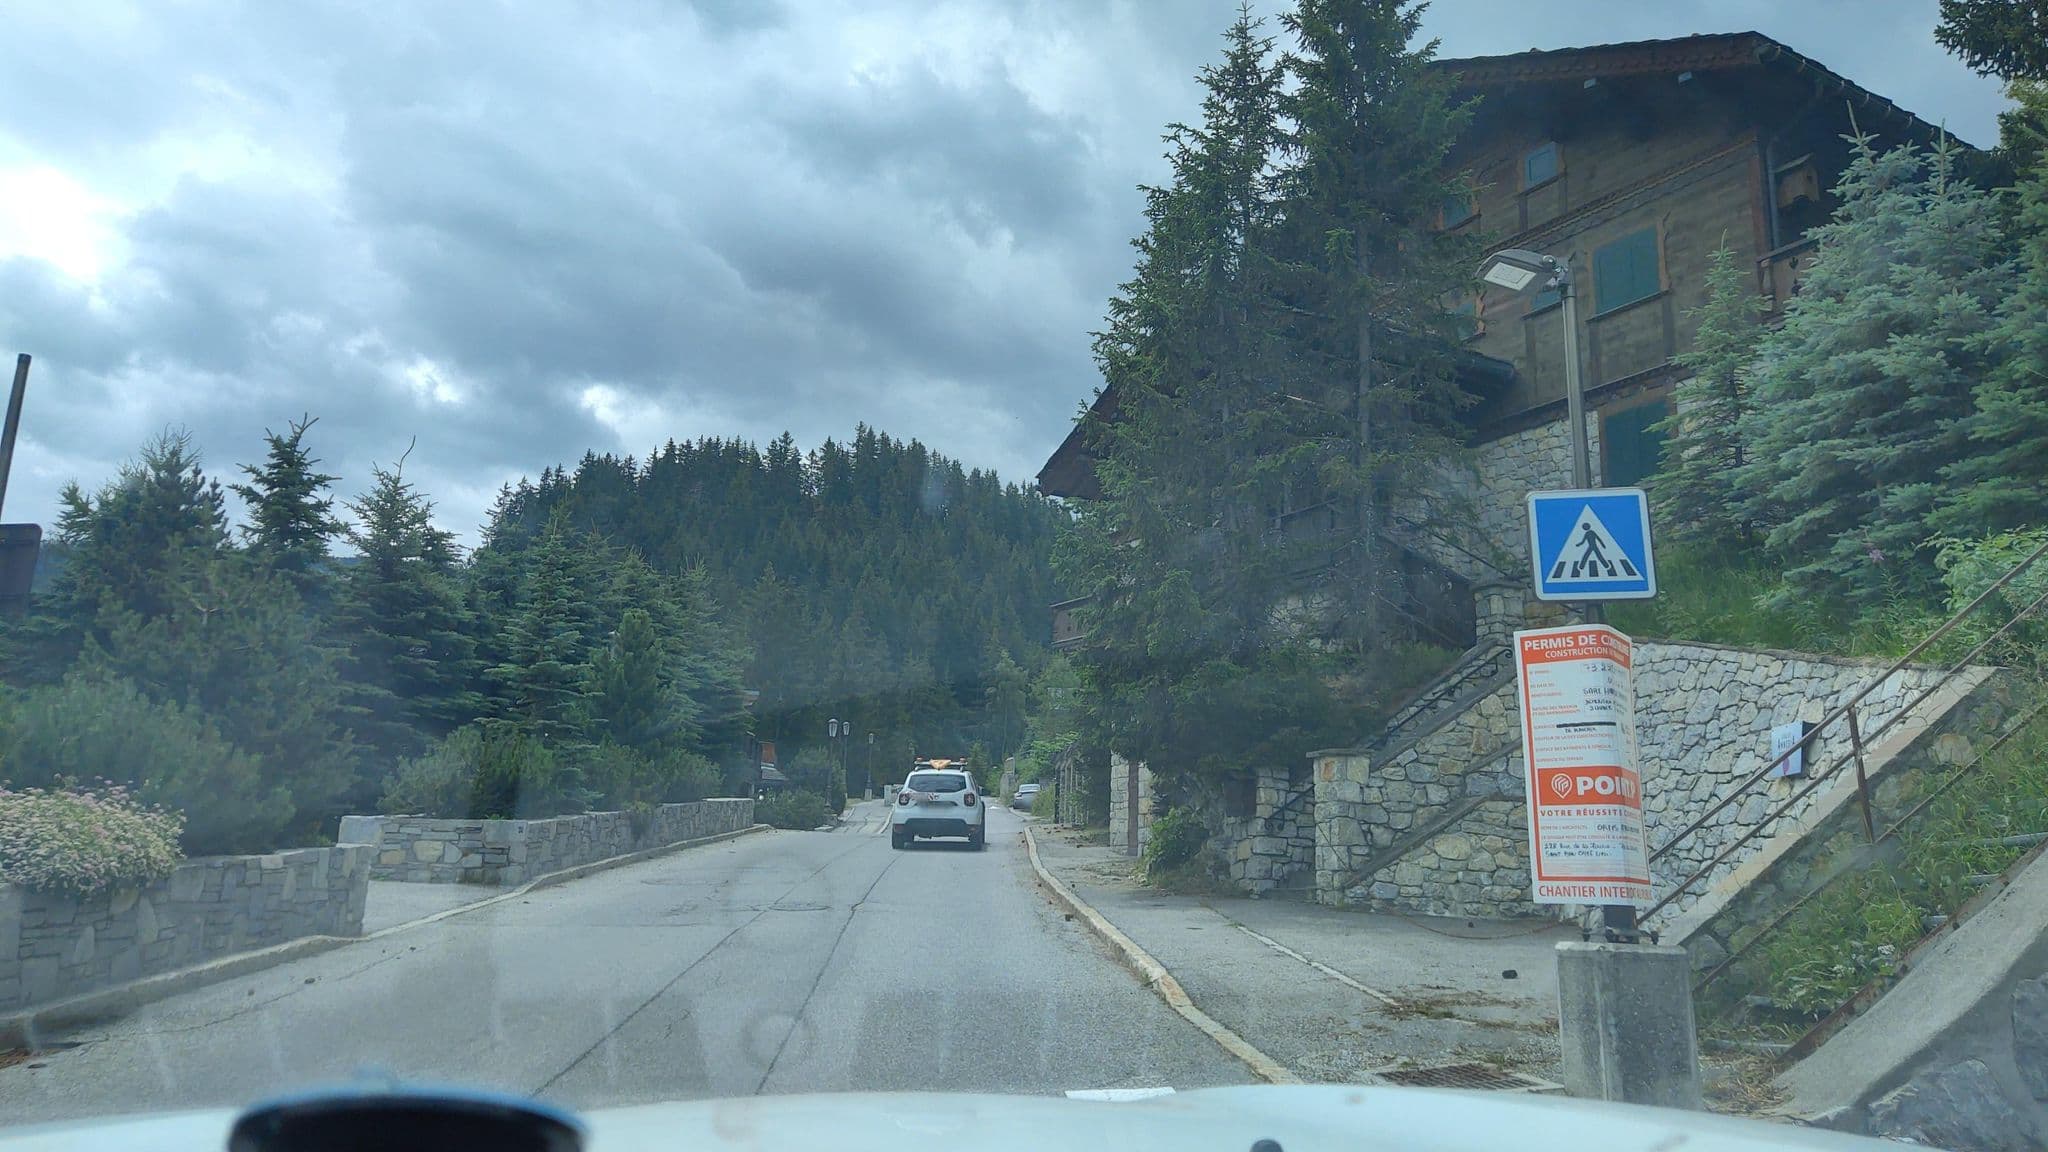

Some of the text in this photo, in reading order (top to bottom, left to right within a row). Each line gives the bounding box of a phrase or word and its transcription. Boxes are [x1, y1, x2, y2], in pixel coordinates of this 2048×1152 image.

[1524, 637, 1574, 651] PERMIS
[1578, 635, 1597, 646] DE
[1545, 647, 1608, 659] CONSTRUCTION
[1540, 809, 1572, 817] VOTRE
[1539, 885, 1596, 898] CHANTIER
